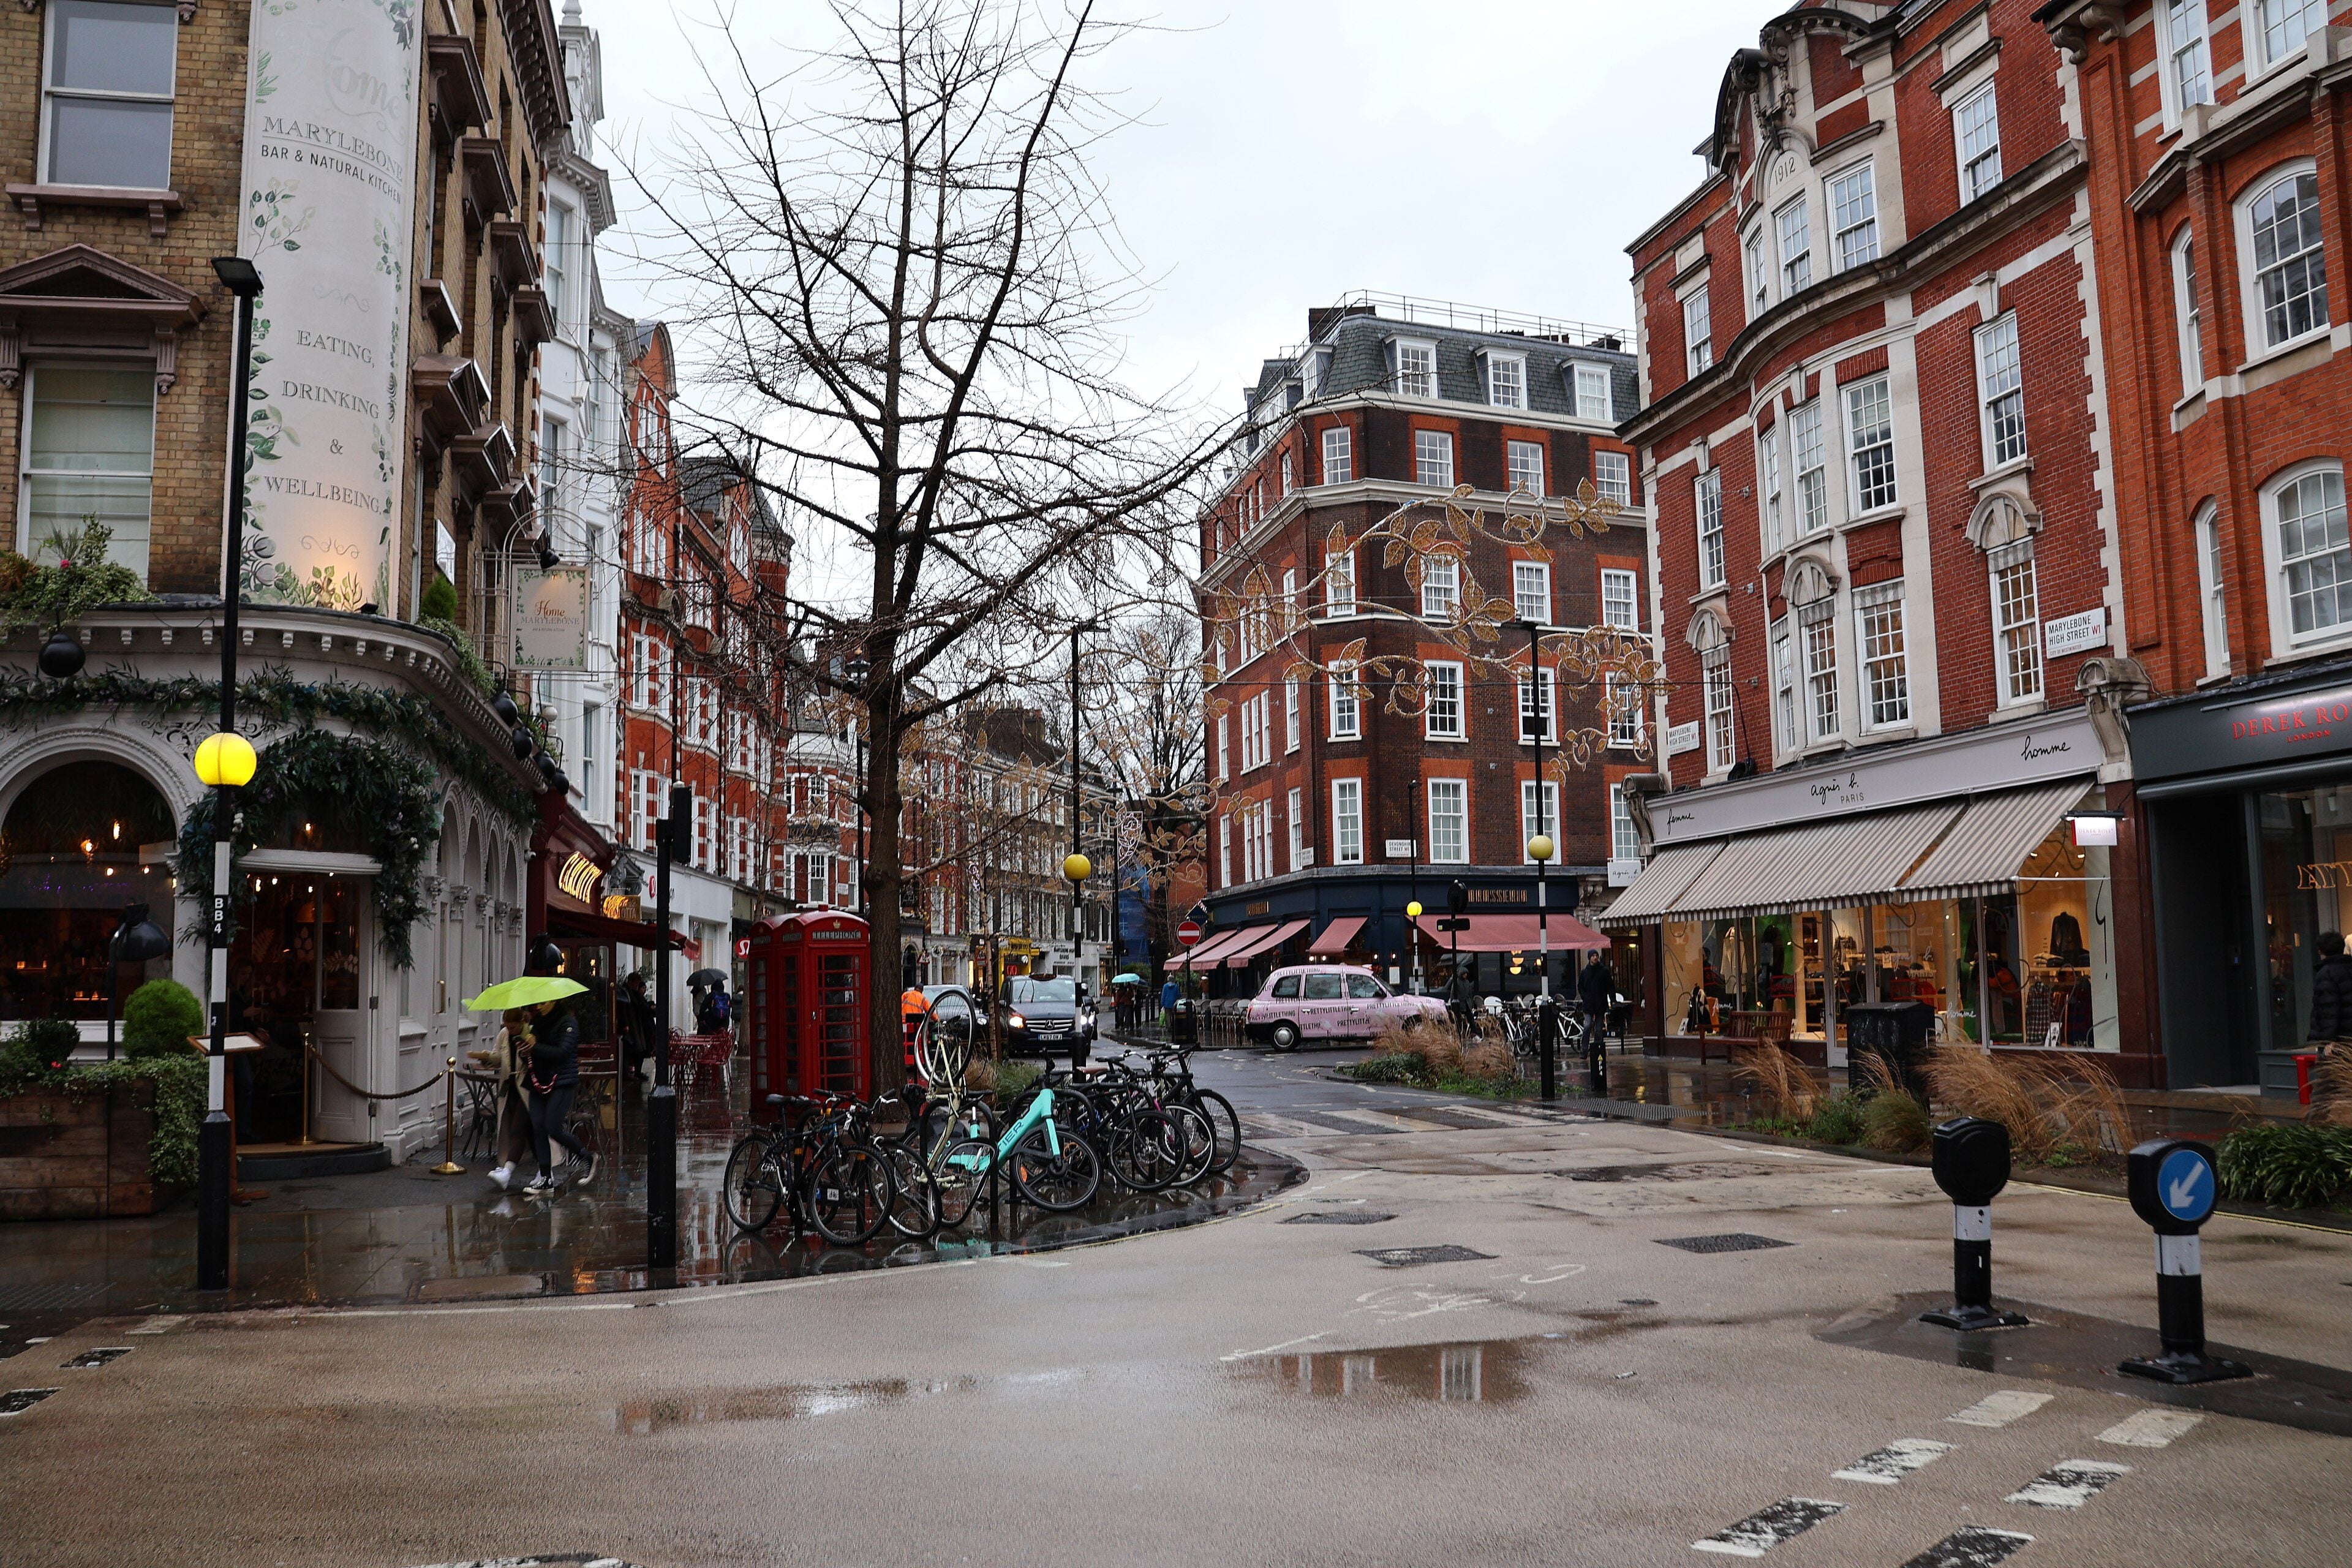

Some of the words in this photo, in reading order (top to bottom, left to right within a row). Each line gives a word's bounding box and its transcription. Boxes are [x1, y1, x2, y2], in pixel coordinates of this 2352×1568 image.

[262, 116, 403, 182] MARYLEBONE
[261, 145, 288, 159] BAR
[295, 149, 303, 162] &
[310, 153, 365, 181] NATURAL
[368, 173, 401, 204] KITCHEN
[1774, 157, 1796, 185] 1912
[297, 330, 375, 368] EATING,
[281, 380, 379, 418] DRINKING
[330, 439, 343, 454] &
[534, 600, 565, 619] Home
[521, 616, 579, 625] MARYLEBONE
[2049, 615, 2091, 634] MARYLEBONE
[2049, 633, 2064, 646] HIGH
[2067, 627, 2089, 641] STREET
[2092, 624, 2101, 635] W1
[2233, 710, 2305, 739] DEREK
[2316, 703, 2352, 725] RO
[1669, 725, 1691, 737] MARYLEBONE
[1669, 738, 1678, 747] HIGH
[1678, 734, 1691, 744] STREET
[2286, 729, 2331, 743] LONDON
[2021, 736, 2071, 761] homme
[1849, 772, 1860, 788] b.
[1841, 792, 1864, 804] PARIS
[1667, 809, 1695, 835] femme
[1468, 889, 1528, 903] BRASSERIA
[1946, 1001, 1977, 1018] homme
